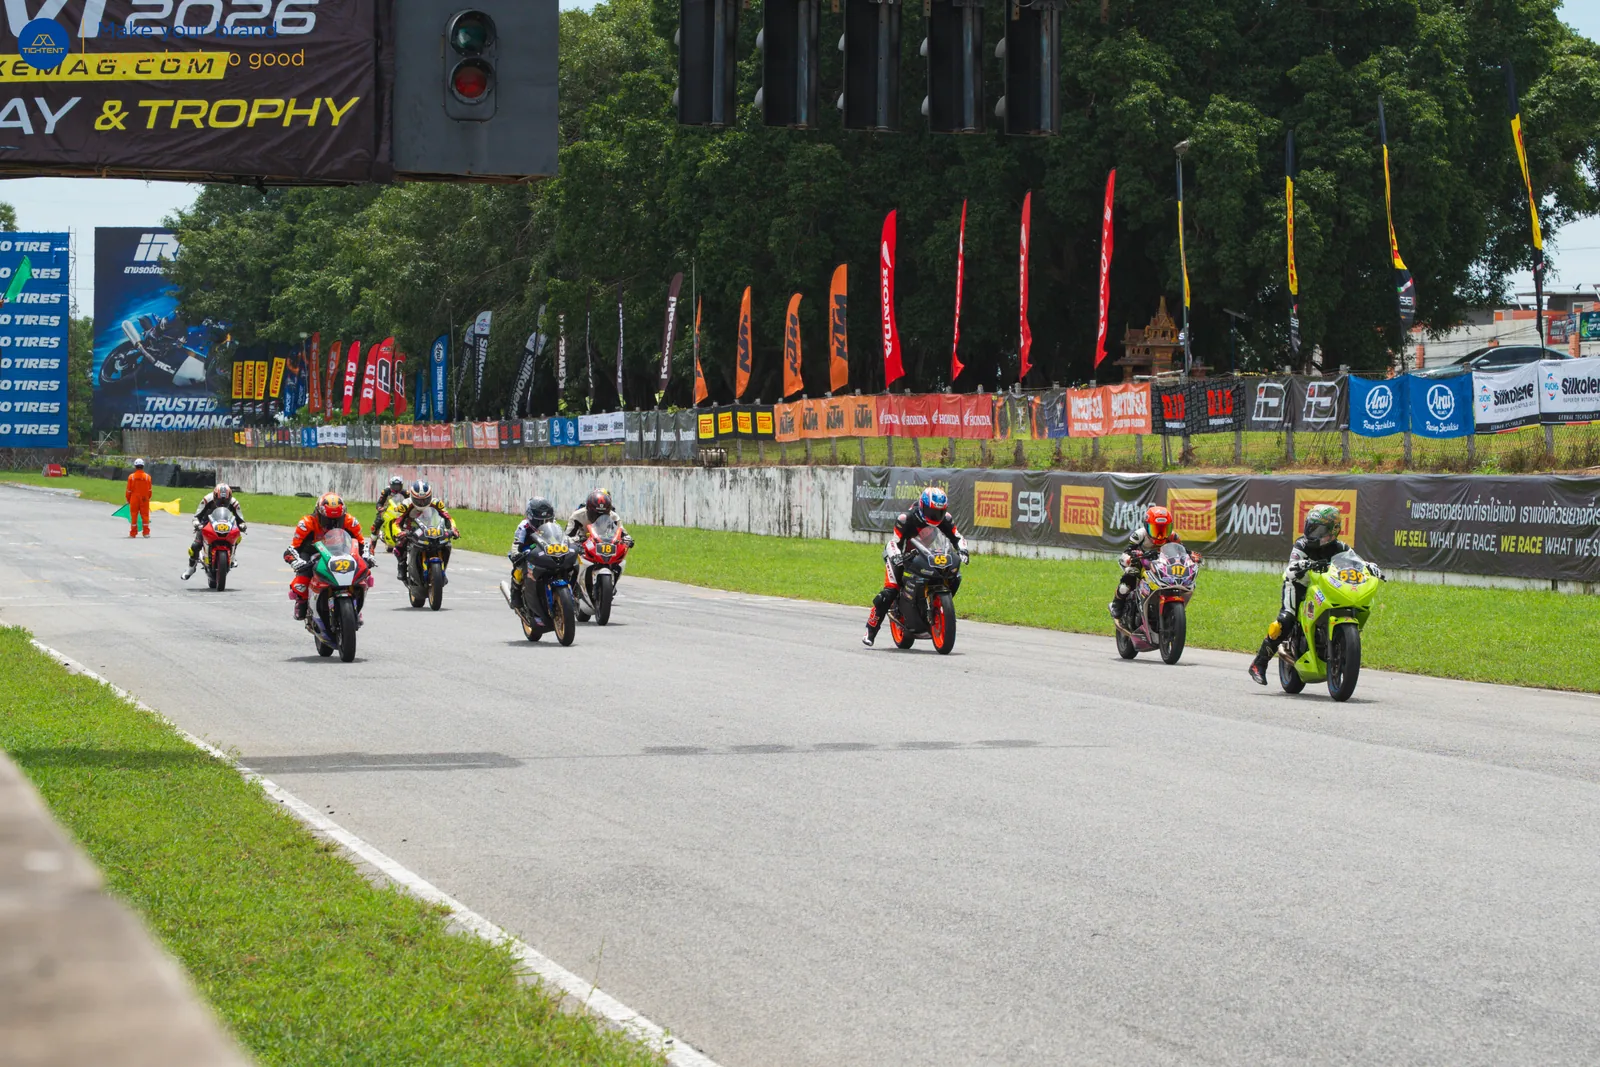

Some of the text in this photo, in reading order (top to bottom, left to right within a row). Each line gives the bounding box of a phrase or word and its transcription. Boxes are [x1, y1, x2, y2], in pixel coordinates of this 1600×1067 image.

[122, 0, 319, 38] 2026
[94, 101, 128, 131] &
[138, 97, 360, 129] TROPHY
[16, 293, 61, 303] TIRES
[882, 267, 892, 358] HONDA
[15, 315, 60, 326] TIRES
[15, 337, 60, 348] TIRES
[15, 359, 60, 369] TIRES
[14, 381, 60, 391] TIRES
[14, 402, 60, 413] TIRES
[145, 397, 218, 412] TRUSTED
[121, 413, 243, 428] PERFORMANCE
[14, 424, 60, 435] TIRES
[977, 490, 1009, 519] PIRELLI
[1063, 495, 1100, 526] PIRELLI
[1170, 499, 1213, 531] PIRELLI
[601, 545, 612, 553] 18
[1394, 530, 1408, 547] WE
[1408, 531, 1428, 548] SELL
[1430, 531, 1455, 549] WHAT
[1457, 532, 1471, 550] WE
[1472, 533, 1498, 555] RACE,
[1501, 535, 1517, 553] WE
[1517, 536, 1544, 554] RACE
[1545, 537, 1573, 555] WHAT
[1575, 538, 1591, 556] WE
[335, 560, 350, 571] 29
[934, 555, 948, 565] 65
[1340, 569, 1364, 582] 539
